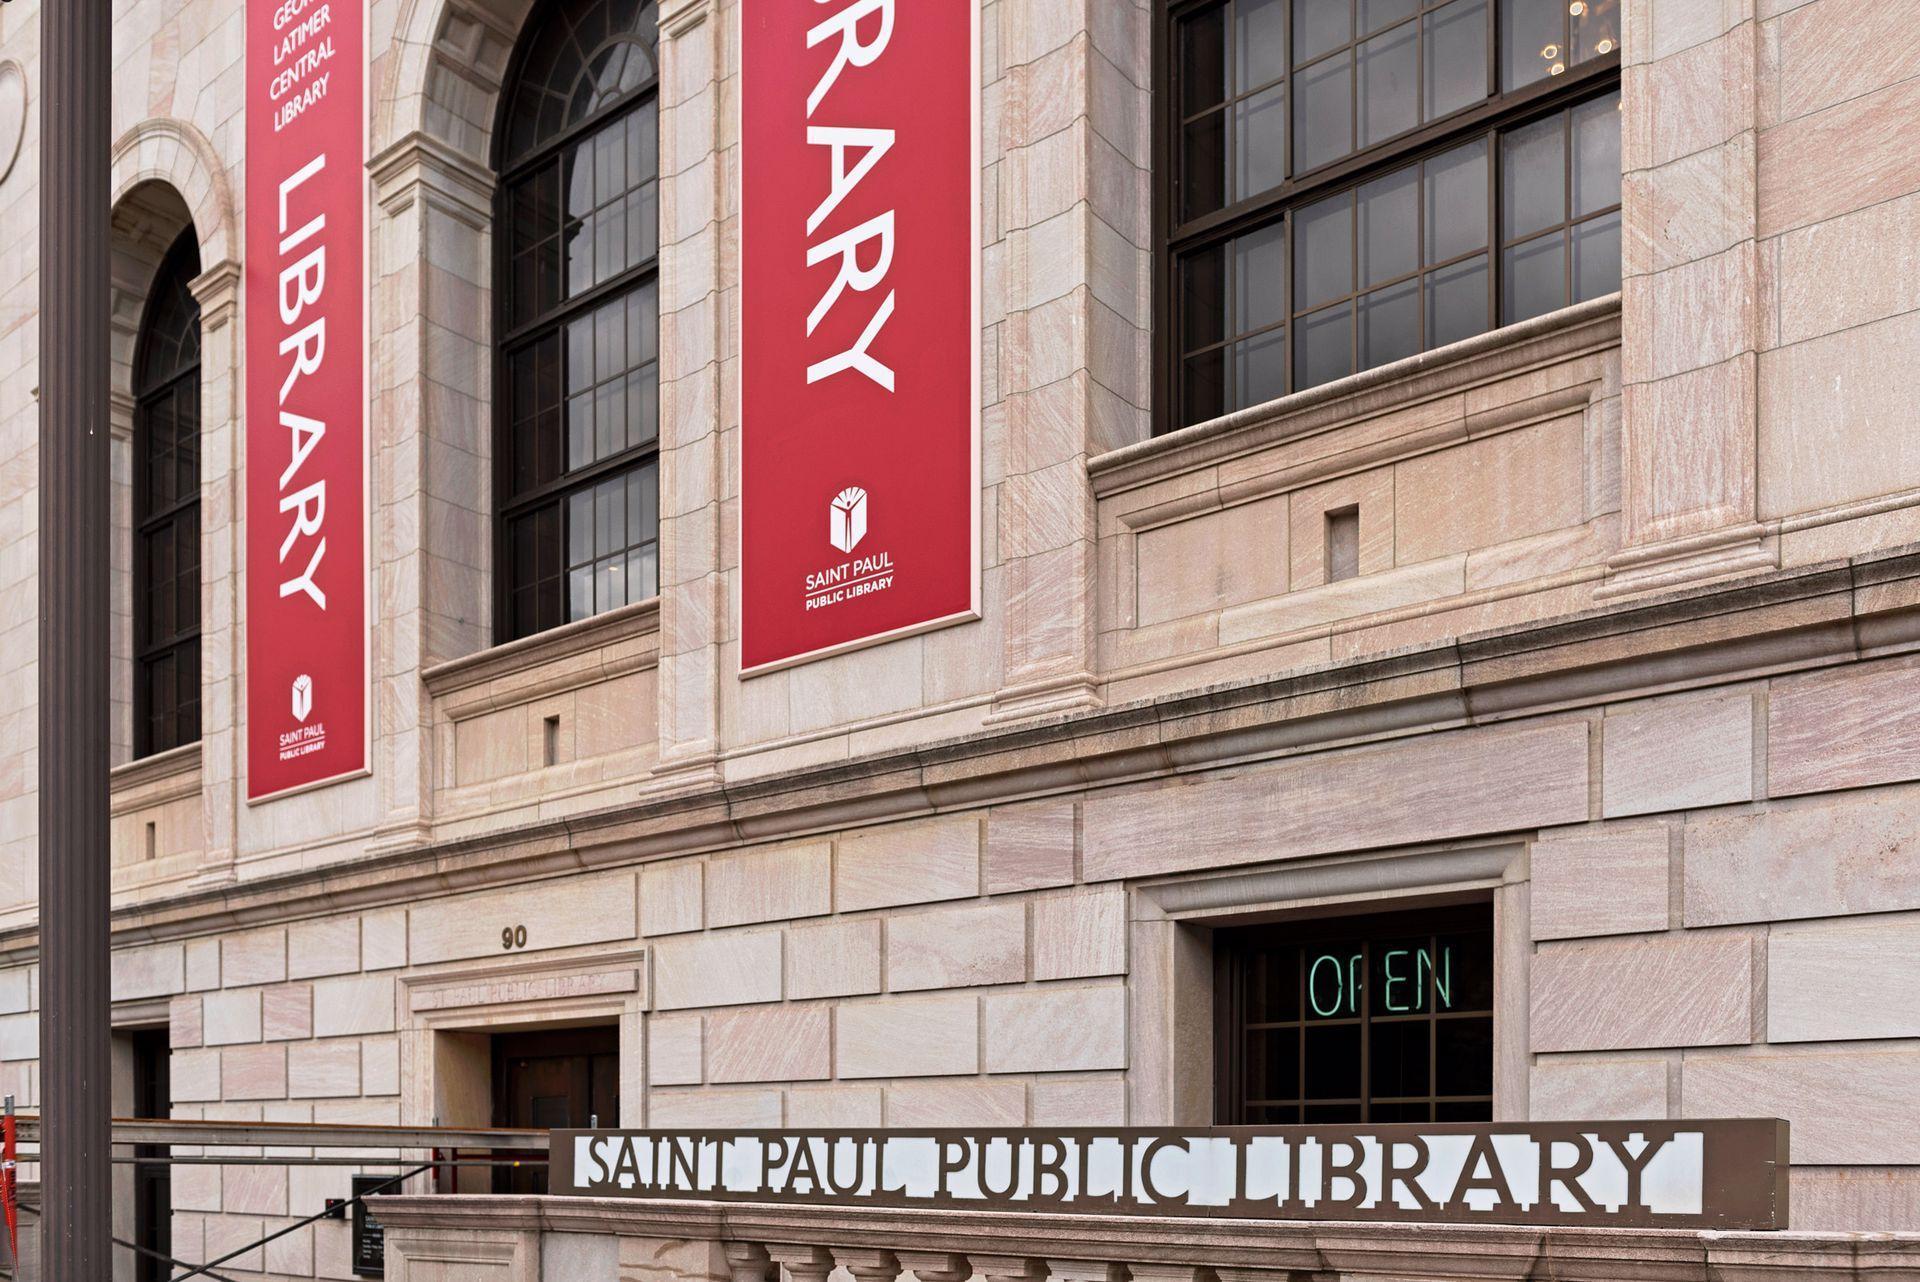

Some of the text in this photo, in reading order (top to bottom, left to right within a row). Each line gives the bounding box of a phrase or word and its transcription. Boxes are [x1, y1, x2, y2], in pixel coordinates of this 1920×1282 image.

[274, 0, 315, 30] GEO
[273, 4, 331, 65] LATIMER
[270, 36, 335, 100] CENTRAL
[274, 72, 329, 131] LIBRARY
[806, 0, 896, 393] RARY
[279, 153, 326, 611] LIBRARY
[806, 552, 894, 590] SAINT PAUL
[806, 576, 893, 611] PUBLIC LIBRARY
[280, 723, 325, 746] SAINT PAUL
[280, 741, 325, 761] PUBLIC LIBRARY
[502, 925, 527, 950] 90
[490, 980, 538, 1002] PUBLIC
[588, 1132, 1675, 1213] SAINT PAUL PUBLIC LIBRARY
